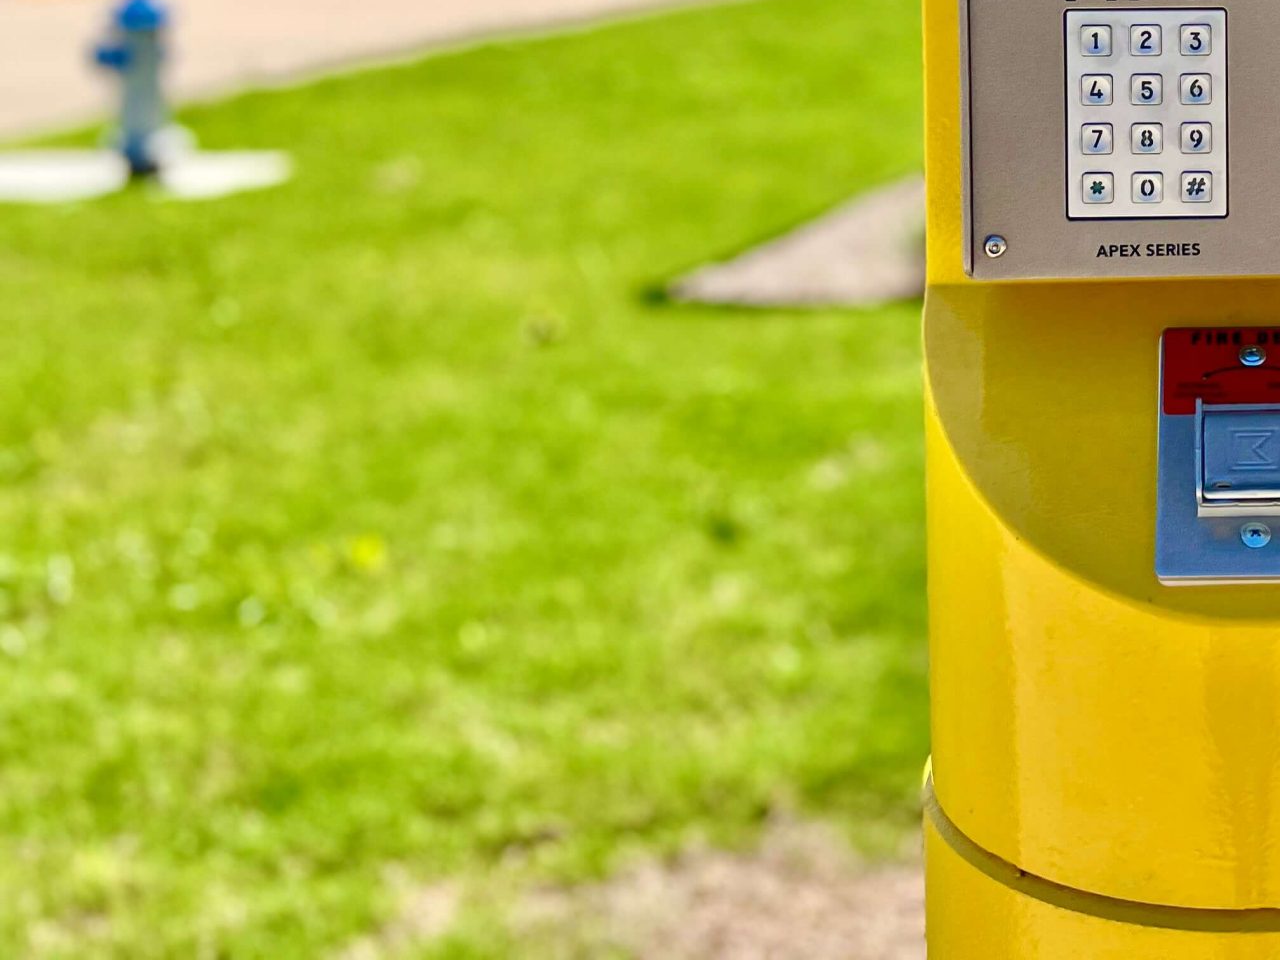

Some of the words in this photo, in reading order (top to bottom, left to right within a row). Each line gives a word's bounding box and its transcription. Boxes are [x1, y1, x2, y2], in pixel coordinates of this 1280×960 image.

[1091, 32, 1099, 50] 1
[1140, 31, 1152, 50] 2
[1189, 32, 1202, 51] 3
[1089, 81, 1104, 99] 4
[1141, 81, 1154, 100] 5
[1189, 79, 1203, 98] 6
[1091, 130, 1103, 148] 7
[1140, 130, 1154, 148] 8
[1189, 130, 1203, 148] 9
[1140, 179, 1155, 197] 0
[1096, 244, 1142, 258] APEX
[1146, 243, 1201, 257] SERIES
[1191, 331, 1242, 345] FIRE
